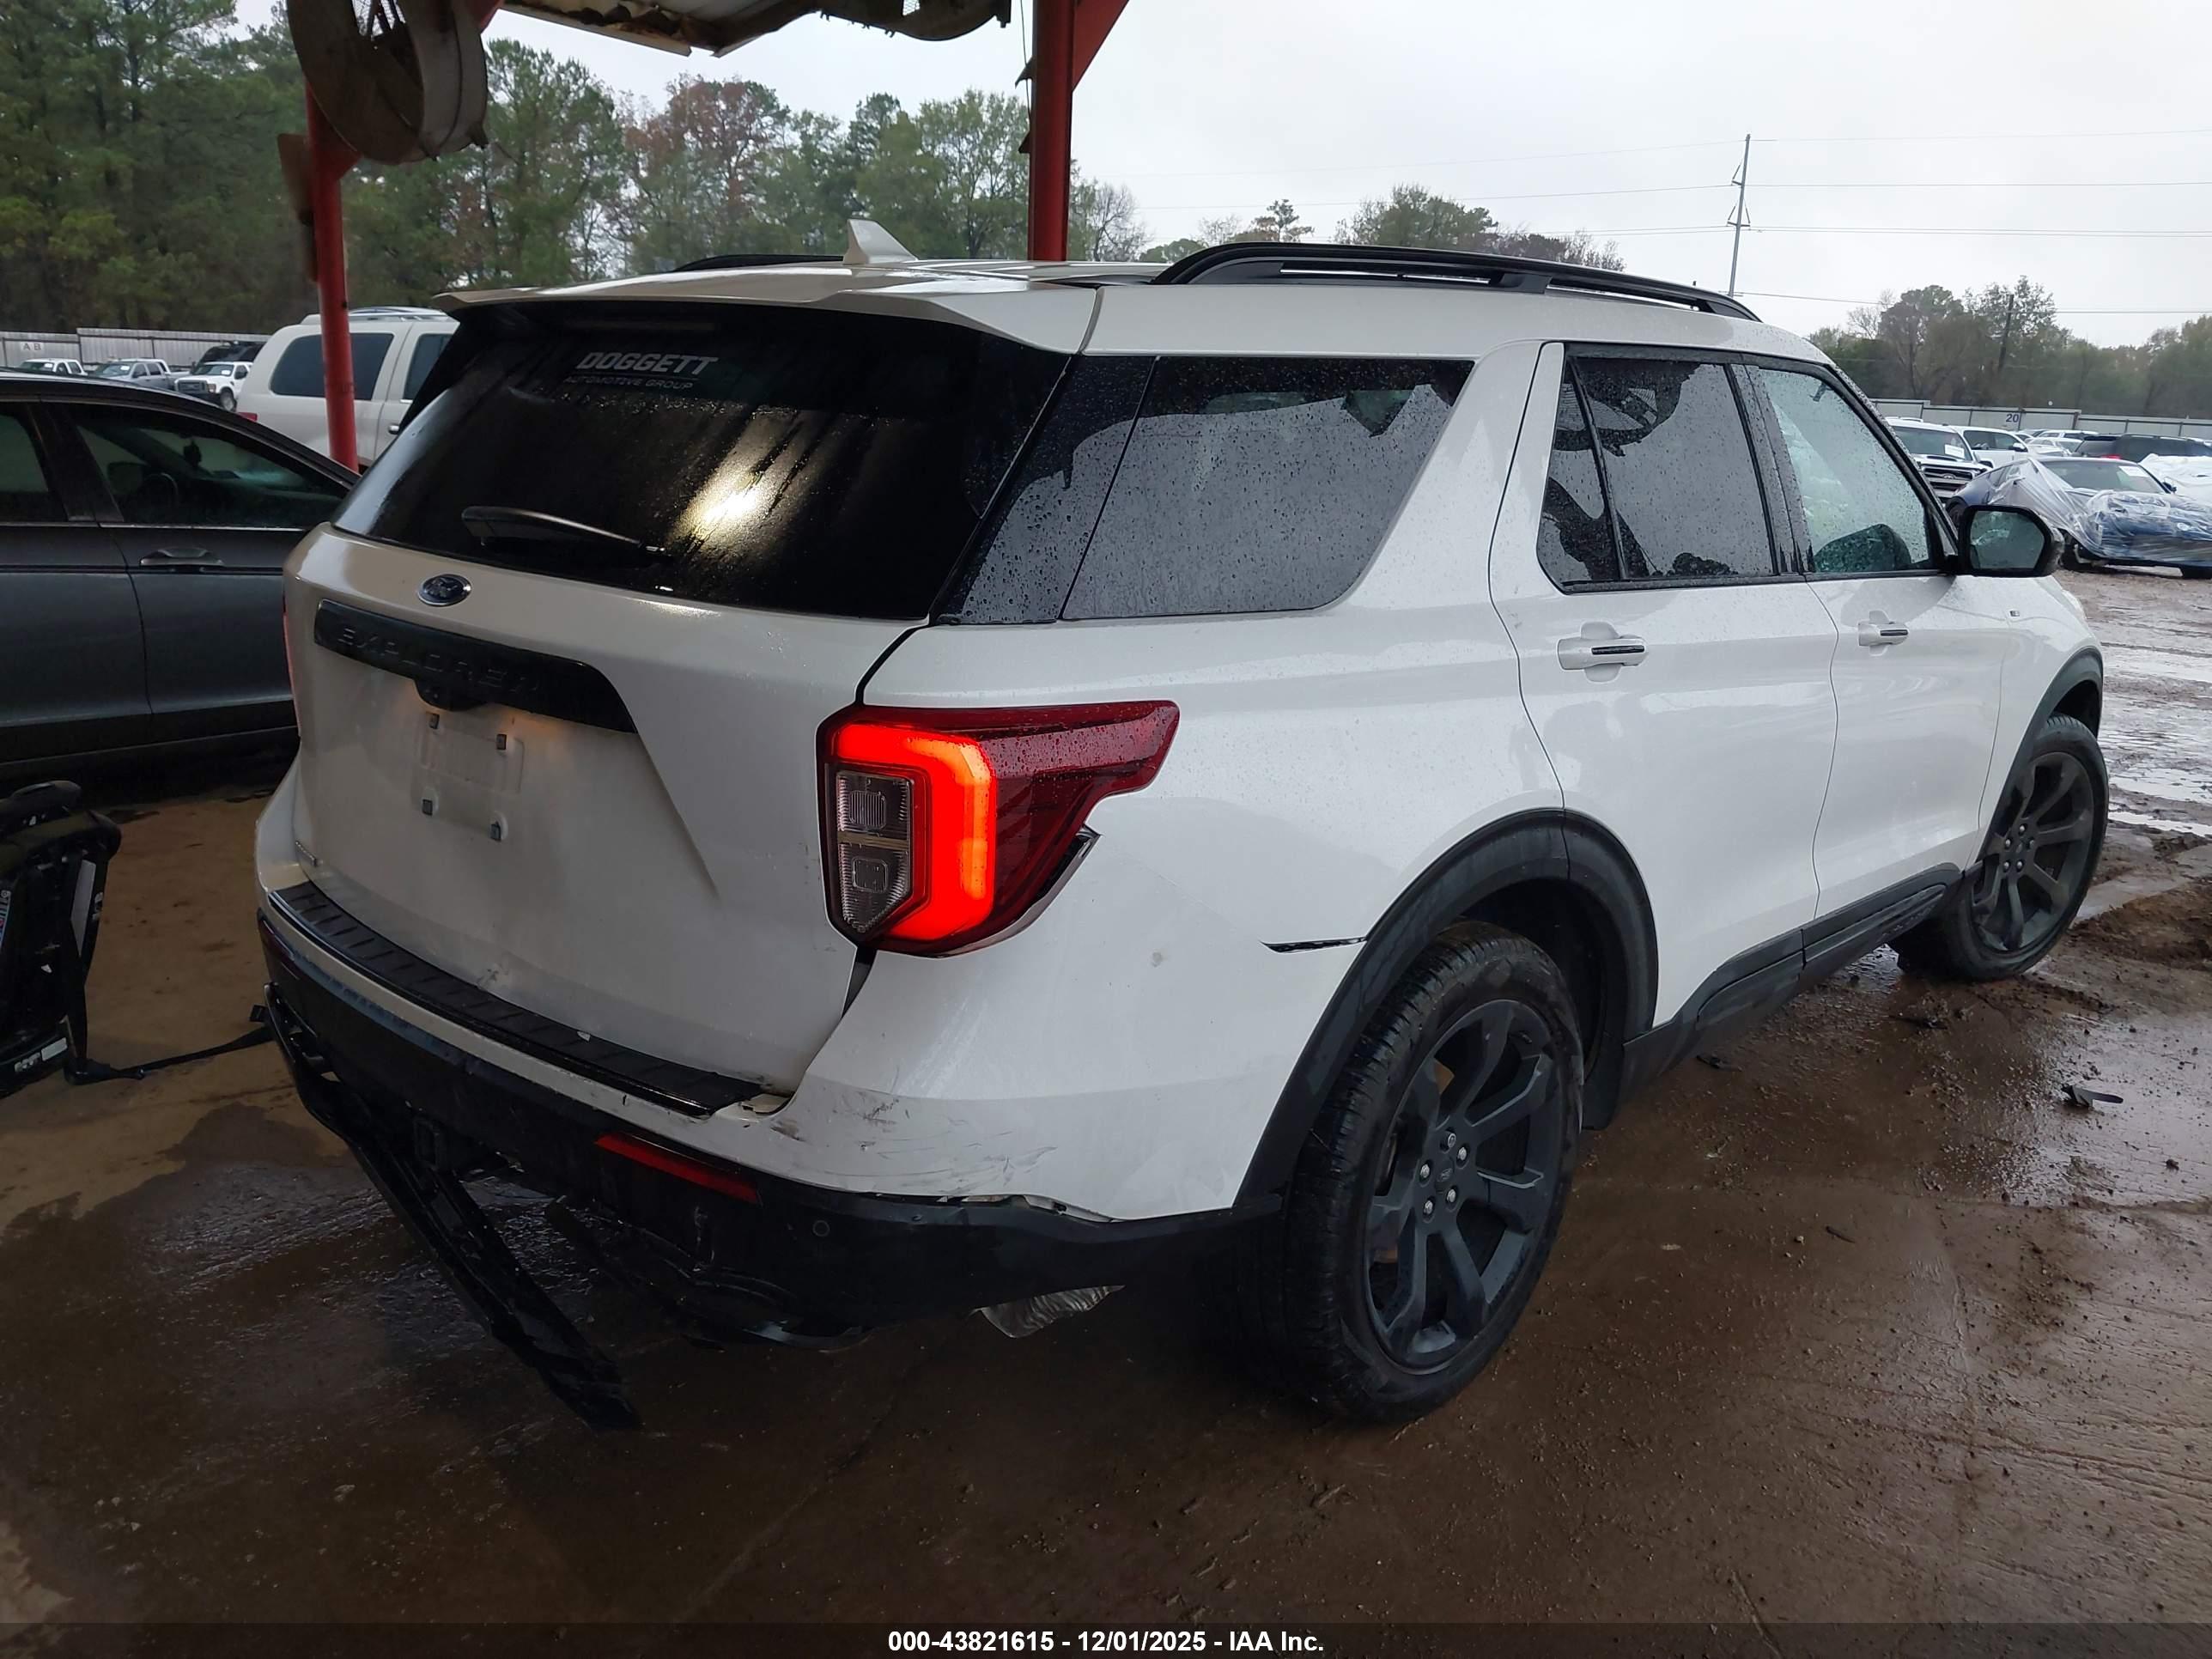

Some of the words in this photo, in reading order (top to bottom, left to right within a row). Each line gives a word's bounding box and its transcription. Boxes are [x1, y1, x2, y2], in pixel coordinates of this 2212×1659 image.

[576, 352, 719, 375] DOGGETT
[563, 376, 643, 386] AUTOMOTIVE
[646, 379, 694, 389] GROUP
[2005, 413, 2020, 423] 20
[337, 628, 542, 692] EXPLORER
